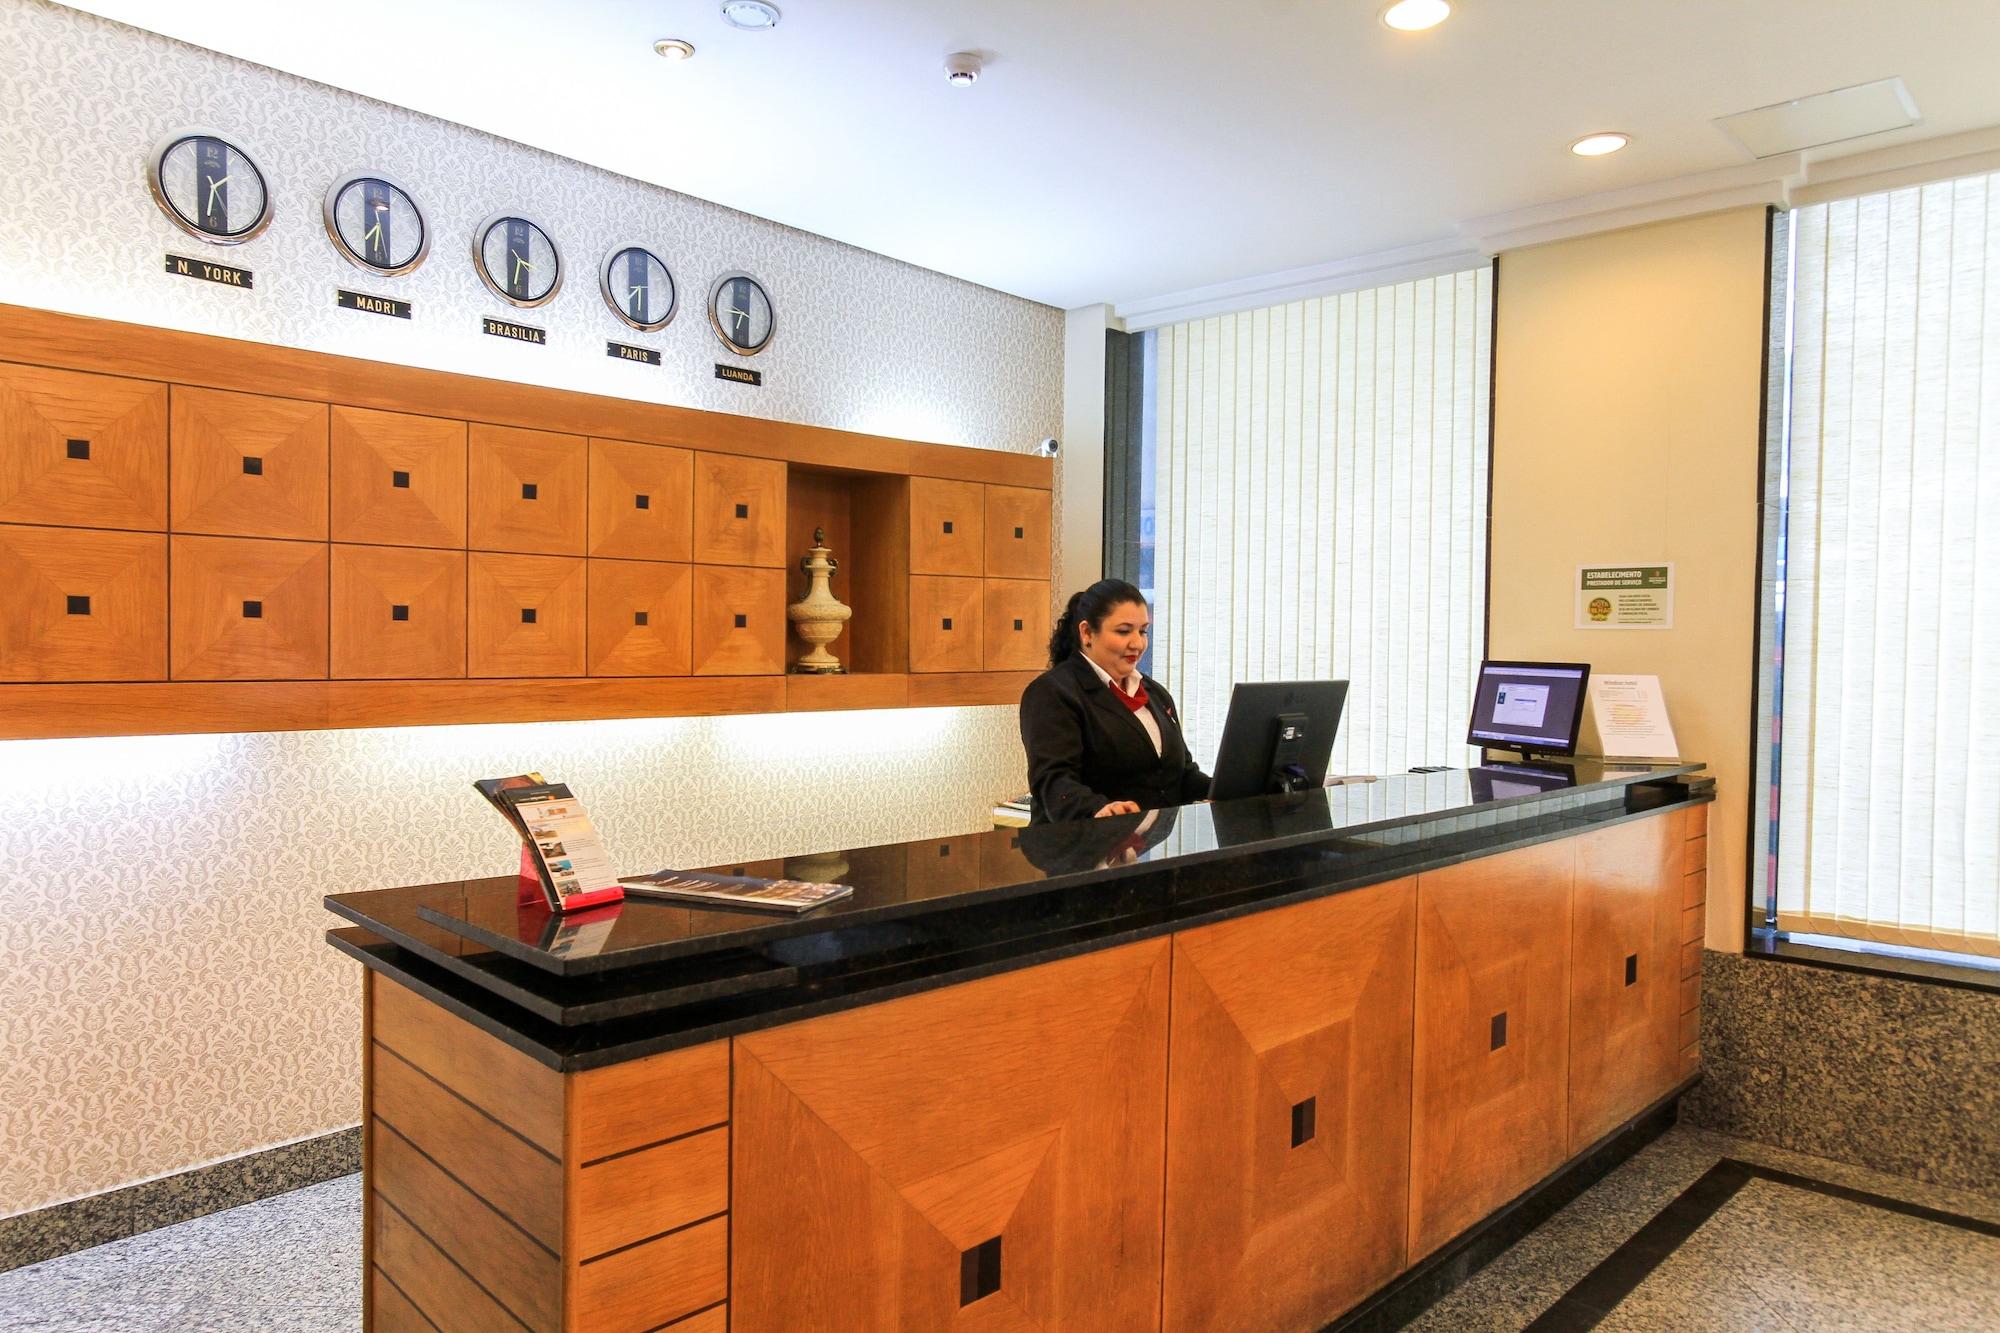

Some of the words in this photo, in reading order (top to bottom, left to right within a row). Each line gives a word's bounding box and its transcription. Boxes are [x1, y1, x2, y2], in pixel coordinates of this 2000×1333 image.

[178, 260, 193, 276] N.
[205, 264, 243, 285] YORK
[355, 296, 397, 315] MADRI
[489, 322, 540, 344] BRASILIA
[620, 347, 649, 363] PARIS
[722, 368, 754, 383] LUANDA
[1587, 571, 1642, 579] ESTABELECIMENTO
